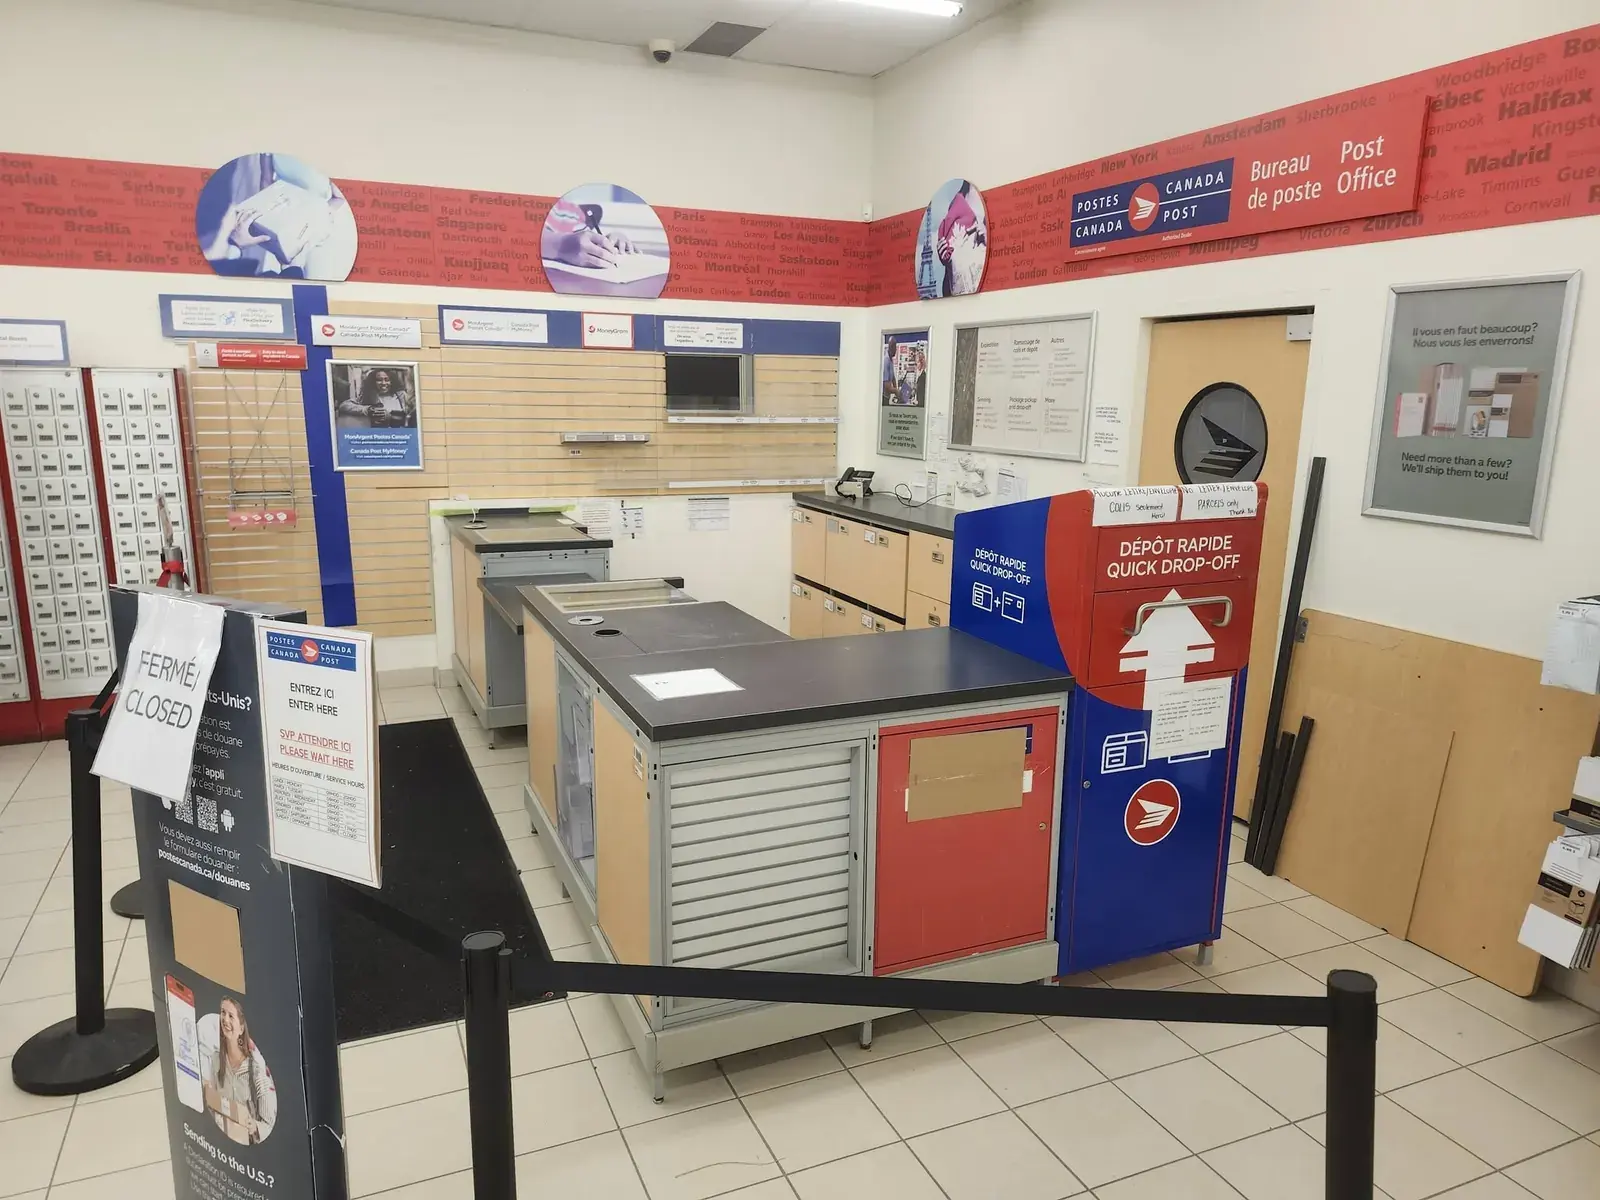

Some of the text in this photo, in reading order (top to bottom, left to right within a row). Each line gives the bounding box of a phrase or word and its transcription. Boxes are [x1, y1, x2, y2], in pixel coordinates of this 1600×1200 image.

[1435, 52, 1548, 89] Woodbridge
[1500, 66, 1587, 98] Victoriaville
[1296, 95, 1377, 124] Sherbrooke
[1430, 88, 1486, 113] ébec
[1498, 87, 1593, 121] Halifax
[1202, 117, 1286, 149] Amsterdam
[1340, 135, 1385, 163] Post
[1465, 142, 1552, 175] Madrid
[1100, 148, 1159, 176] New York
[1250, 154, 1311, 182] Bureau
[1052, 168, 1097, 188] Lethbridge
[1165, 171, 1225, 195] CANADA
[1337, 165, 1397, 195] Office
[1481, 175, 1542, 196] Timmins
[121, 180, 187, 198] Sydney
[362, 185, 425, 199] Lethbridge
[1247, 180, 1322, 211] de poste
[22, 201, 98, 218] Toronto
[350, 198, 429, 213] os Angeles
[441, 206, 461, 216] Red
[1077, 194, 1120, 213] POSTES
[1504, 193, 1572, 215] Cornwall
[673, 211, 706, 222] Paris
[740, 216, 784, 229] Brampton
[1163, 205, 1199, 223] POST
[359, 226, 431, 240] askatoon
[436, 217, 507, 232] Singapore
[1075, 219, 1123, 239] CANADA
[1300, 223, 1350, 242] Victoria
[442, 232, 502, 245] Dartmouth
[673, 234, 776, 252] Ottawa Abbotsford
[774, 230, 841, 245] Los Angeles
[704, 261, 760, 275] Montréal
[766, 265, 806, 277] Thornhill
[779, 254, 841, 267] Saskatoon
[746, 276, 775, 287] Surrey
[1014, 267, 1048, 281] London
[596, 327, 630, 335] MoneyGram
[1412, 321, 1539, 337] Il vous en faut beaucoup?
[1413, 335, 1535, 348] Nous vous les enverrons!
[1401, 451, 1513, 469] Need more than a few?
[1401, 462, 1509, 482] We'll ship them to you!
[1109, 501, 1131, 513] COLIS
[1197, 499, 1240, 511] PARCELS only
[1119, 535, 1233, 557] DÉPÔT RAPIDE
[975, 547, 1027, 572] DÉPÔT RAPIDE
[1106, 554, 1241, 579] QUICK DROP-OFF
[970, 559, 1031, 586] QUICK DROP-OFF
[269, 636, 295, 646] POSTES
[320, 643, 352, 654] CANADA
[270, 648, 299, 659] CANADA
[321, 656, 340, 665] POST
[139, 649, 201, 692] FERMÉ/
[206, 689, 252, 711] ts-Unis?
[290, 682, 335, 699] ENTREZ ICI
[125, 689, 193, 730] CLOSED
[288, 698, 338, 717] ENTER HERE
[200, 714, 231, 732] ation est
[203, 729, 243, 749] de douane
[279, 728, 352, 753] SVP ATTENDRE ICI
[194, 741, 231, 759] prépayés.
[279, 744, 355, 770] PLEASE WAIT HERE
[271, 761, 289, 772] HEURES
[326, 774, 346, 786] SERVICE
[347, 779, 366, 790] HOURS
[198, 778, 244, 799] c'est gratuit.
[159, 821, 241, 861] Vous devez aussi remplir
[164, 836, 170, 848] le
[203, 854, 236, 873] douanier
[158, 849, 251, 891] postescanada.ca/douanes
[183, 1122, 217, 1158] Sending
[217, 1149, 227, 1163] to
[229, 1155, 246, 1175] the
[247, 1165, 275, 1188] U.S.?
[188, 1144, 219, 1178] Declaration
